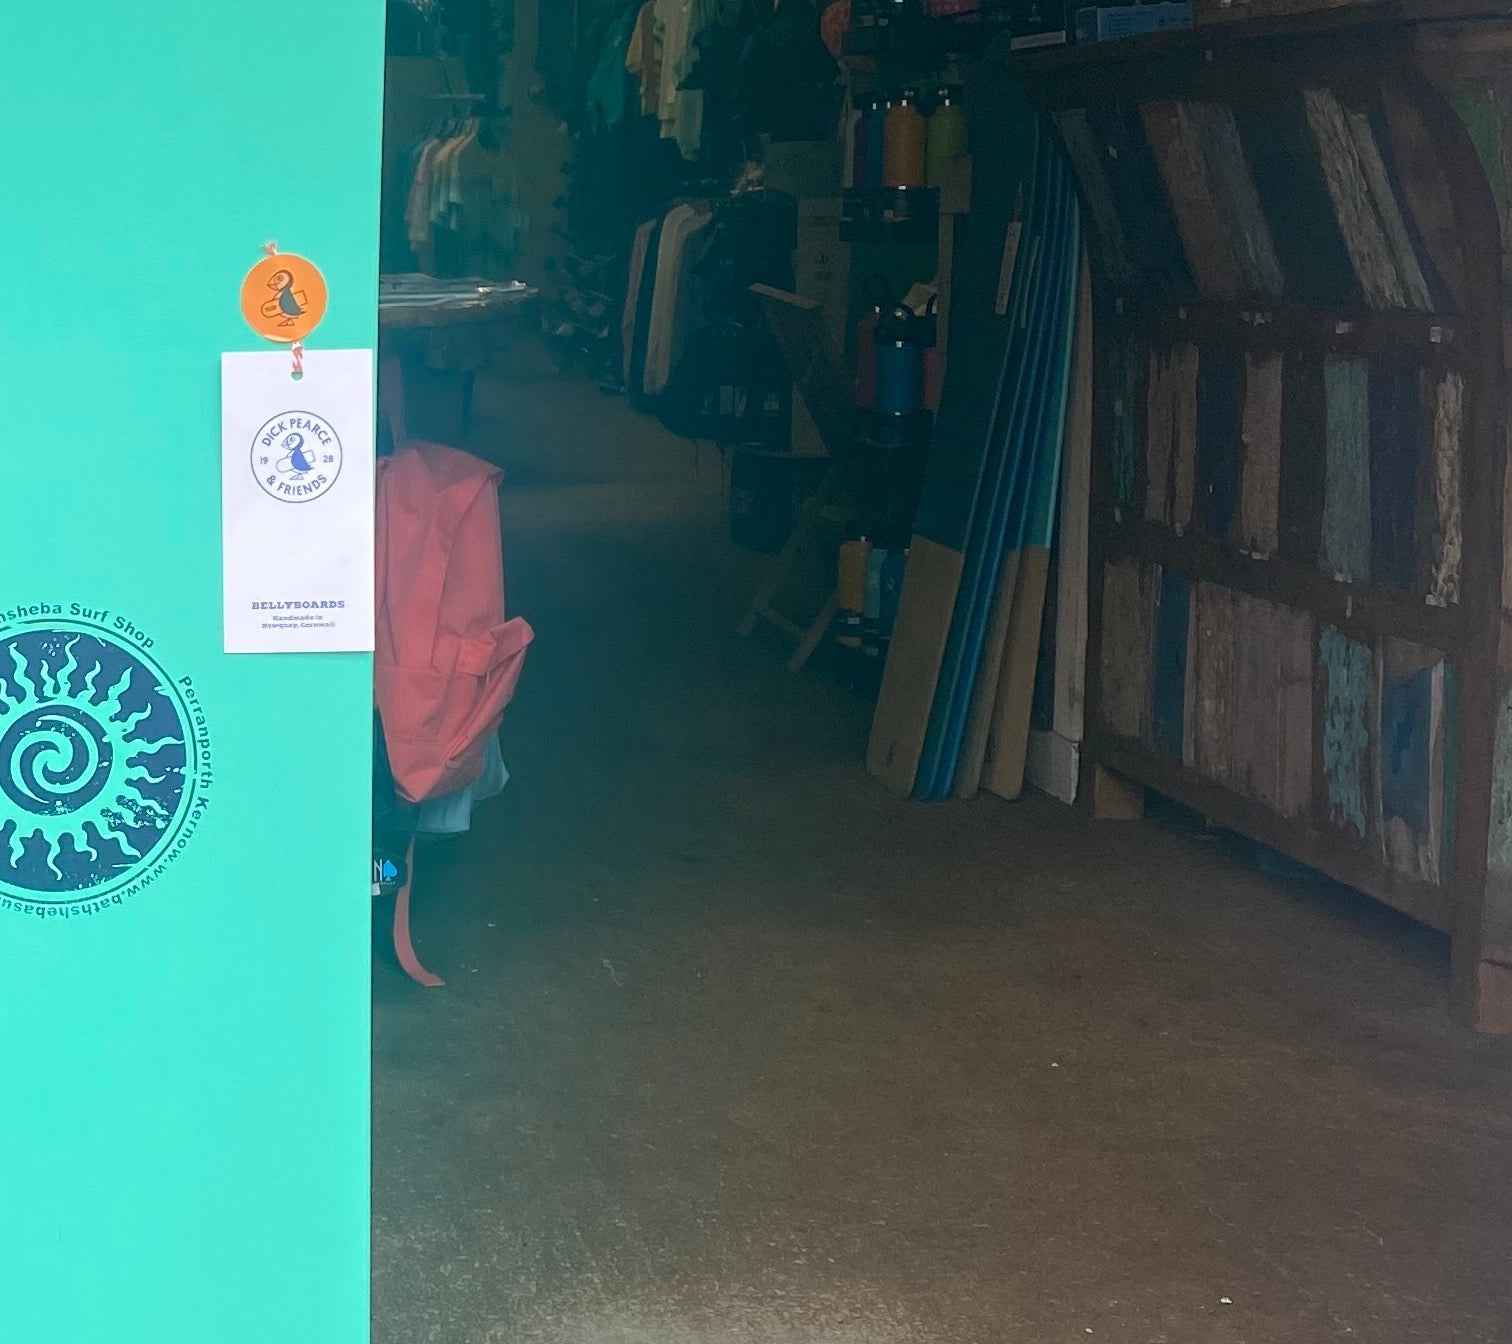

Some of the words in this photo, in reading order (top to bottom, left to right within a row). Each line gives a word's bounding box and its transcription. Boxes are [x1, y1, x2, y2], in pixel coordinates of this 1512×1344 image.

[262, 421, 287, 447] DICK
[289, 418, 332, 446] PEARCE
[266, 474, 276, 486] &
[277, 474, 327, 496] FRIENDS
[251, 600, 345, 610] BELLYBOARDS
[69, 602, 109, 623] Surf
[113, 615, 155, 649] Shop
[179, 675, 213, 790] Perranporth
